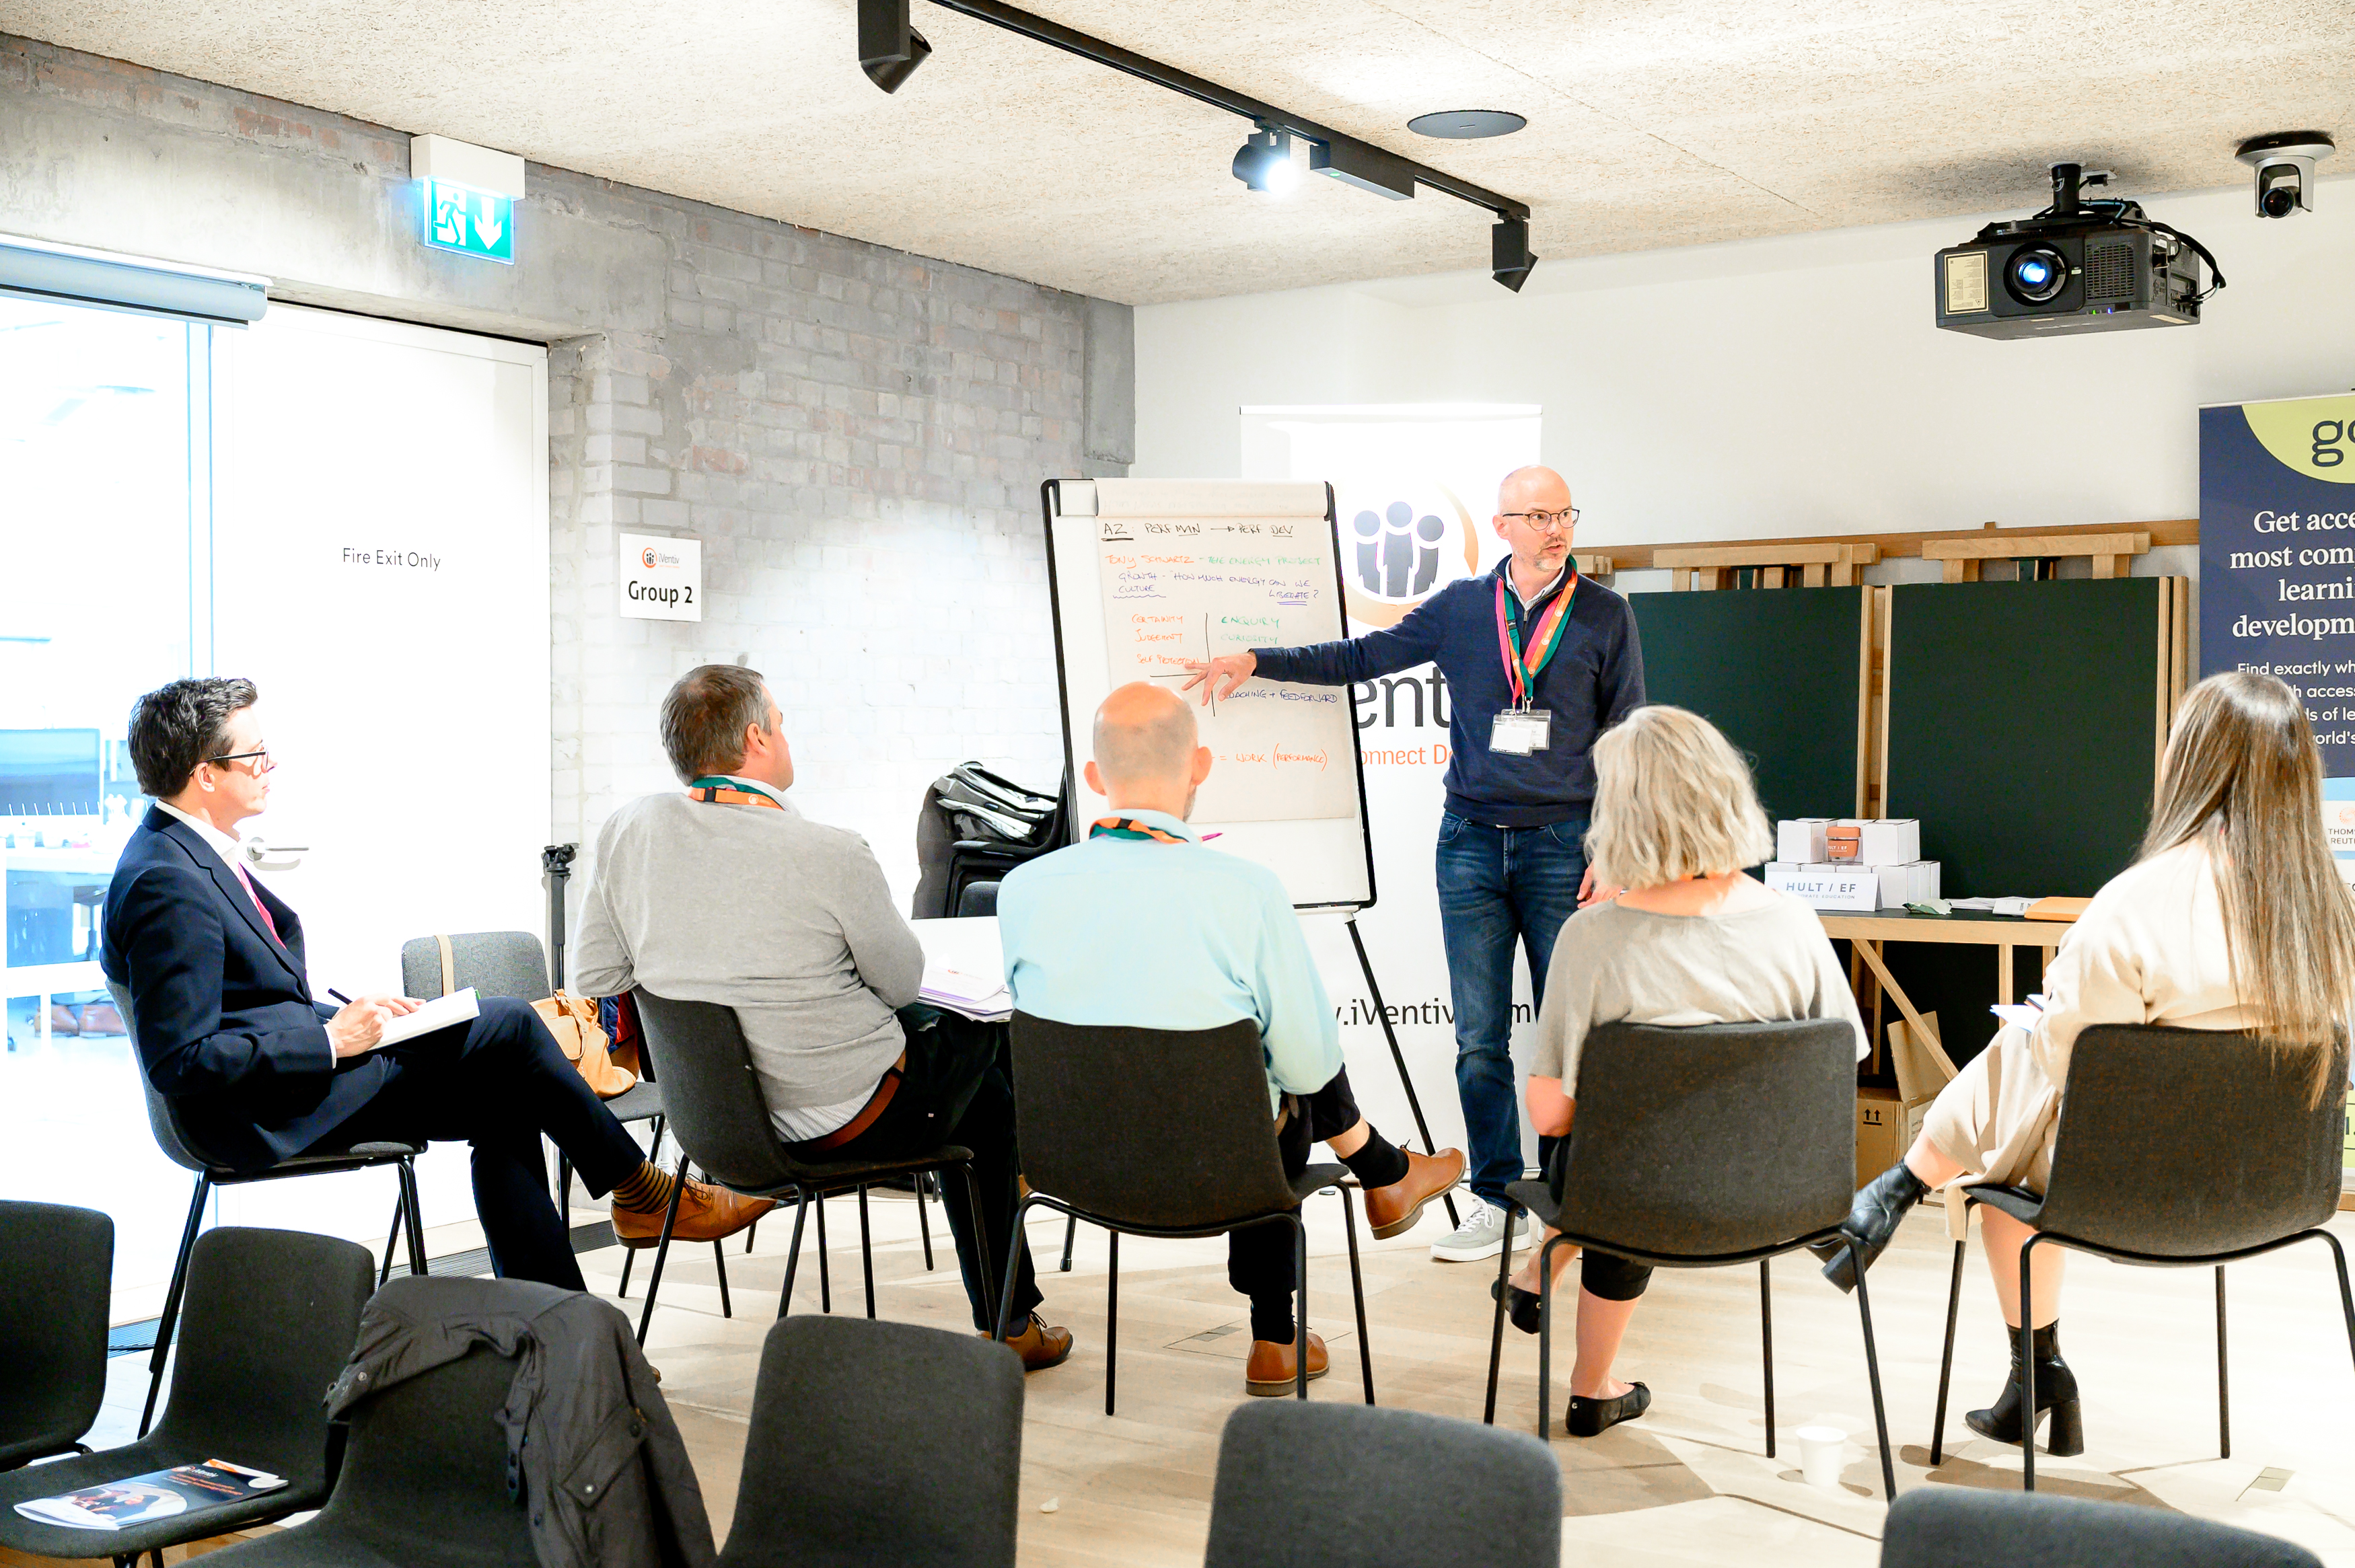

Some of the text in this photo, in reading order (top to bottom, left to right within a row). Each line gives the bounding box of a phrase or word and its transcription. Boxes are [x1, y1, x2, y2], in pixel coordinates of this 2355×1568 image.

[2312, 419, 2355, 467] g
[1144, 523, 1171, 533] PERF
[1175, 523, 1200, 533] MAN
[1235, 523, 1262, 534] PERF
[1270, 525, 1293, 535] DEV
[2254, 511, 2300, 533] Get
[343, 548, 441, 572] Fire Exit Only
[1105, 554, 1137, 569] TONY
[1140, 555, 1195, 564] SCHWARTZ
[1229, 556, 1270, 567] ENERGY
[2230, 546, 2355, 569] most com
[1118, 570, 1157, 583] GROWTH
[1229, 576, 1266, 586] ENERGY
[1295, 579, 1311, 587] WE
[628, 581, 693, 608] Group 2
[1118, 585, 1155, 593] CULTURE
[2278, 576, 2355, 601] learni
[1221, 615, 1280, 629] ENQUIRY
[2232, 613, 2355, 640] developm
[1221, 633, 1278, 644] CURIOSITY
[1136, 654, 1153, 664] SELF
[2237, 659, 2355, 677] Find exactly wh
[1226, 689, 1266, 700] OACHING
[1280, 689, 1338, 703] FEEDFORWARD
[1354, 666, 1451, 729] ent
[2307, 687, 2355, 698] acces
[2322, 706, 2338, 721] of
[2343, 706, 2355, 721] le
[2313, 731, 2355, 745] orld's
[1236, 753, 1268, 763] WORK
[1273, 743, 1328, 772] (PERFORMANCE)
[1361, 747, 1426, 765] onnect
[1786, 882, 1823, 892] HULT
[1840, 883, 1856, 893] EF
